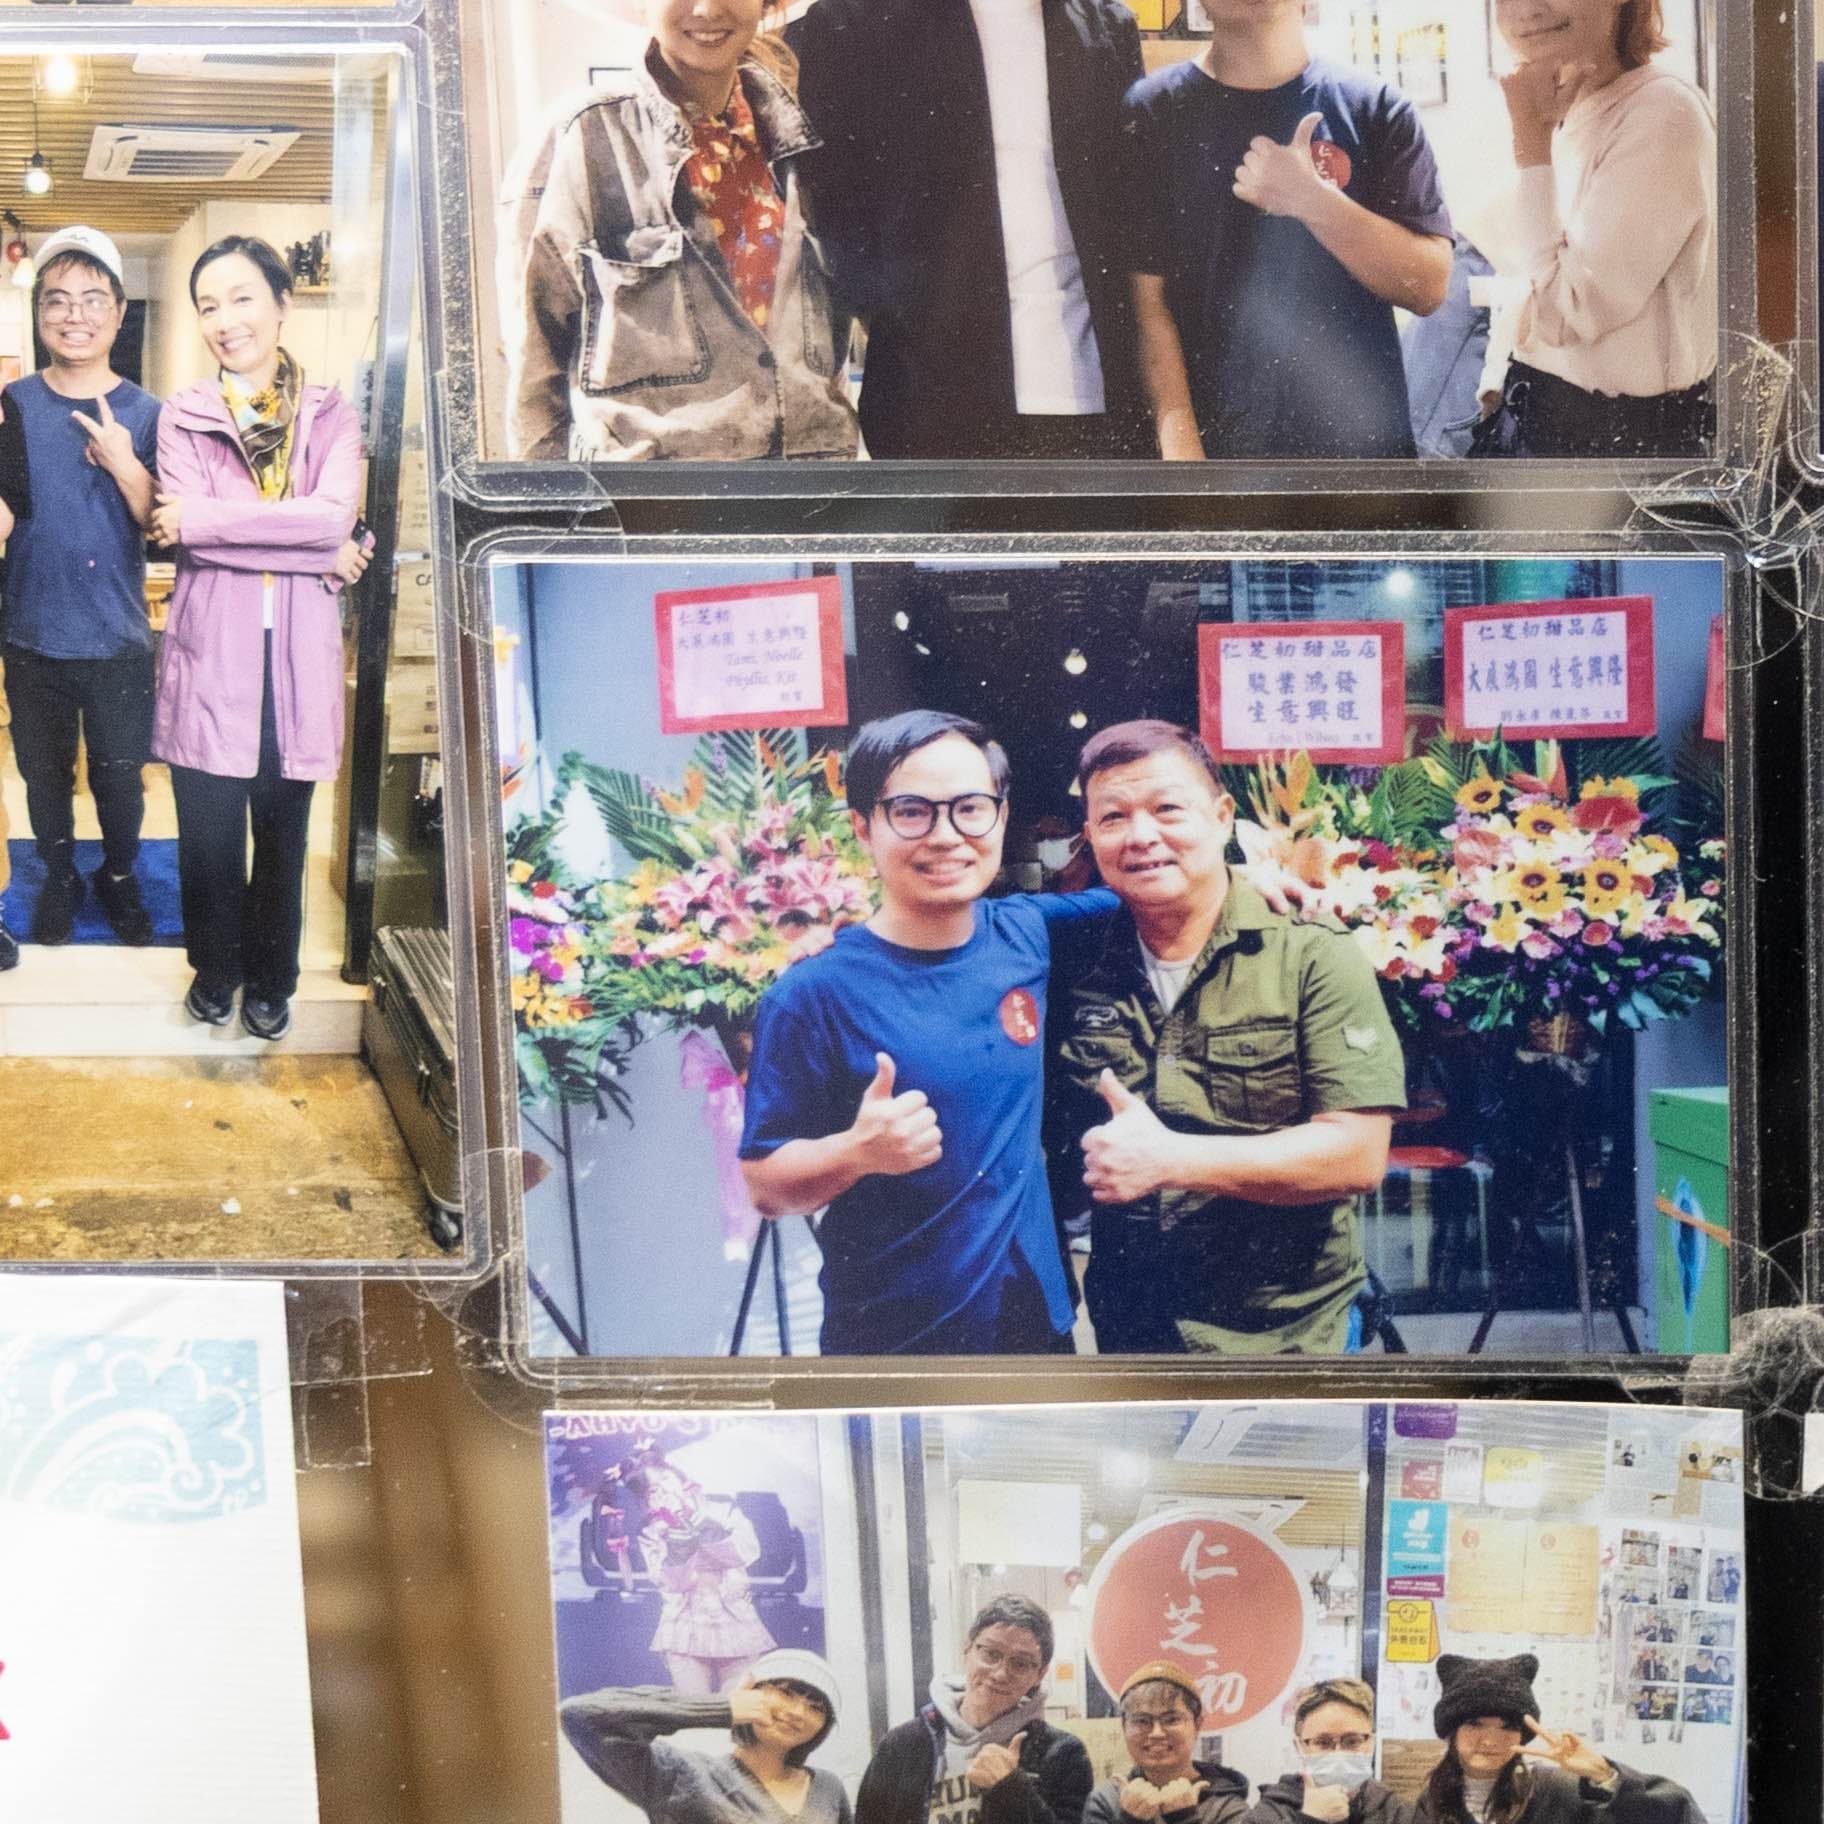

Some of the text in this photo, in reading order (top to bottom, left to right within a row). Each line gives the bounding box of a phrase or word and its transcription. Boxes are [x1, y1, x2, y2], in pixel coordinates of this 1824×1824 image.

[1222, 639, 1377, 660] 仁芝初甜品店
